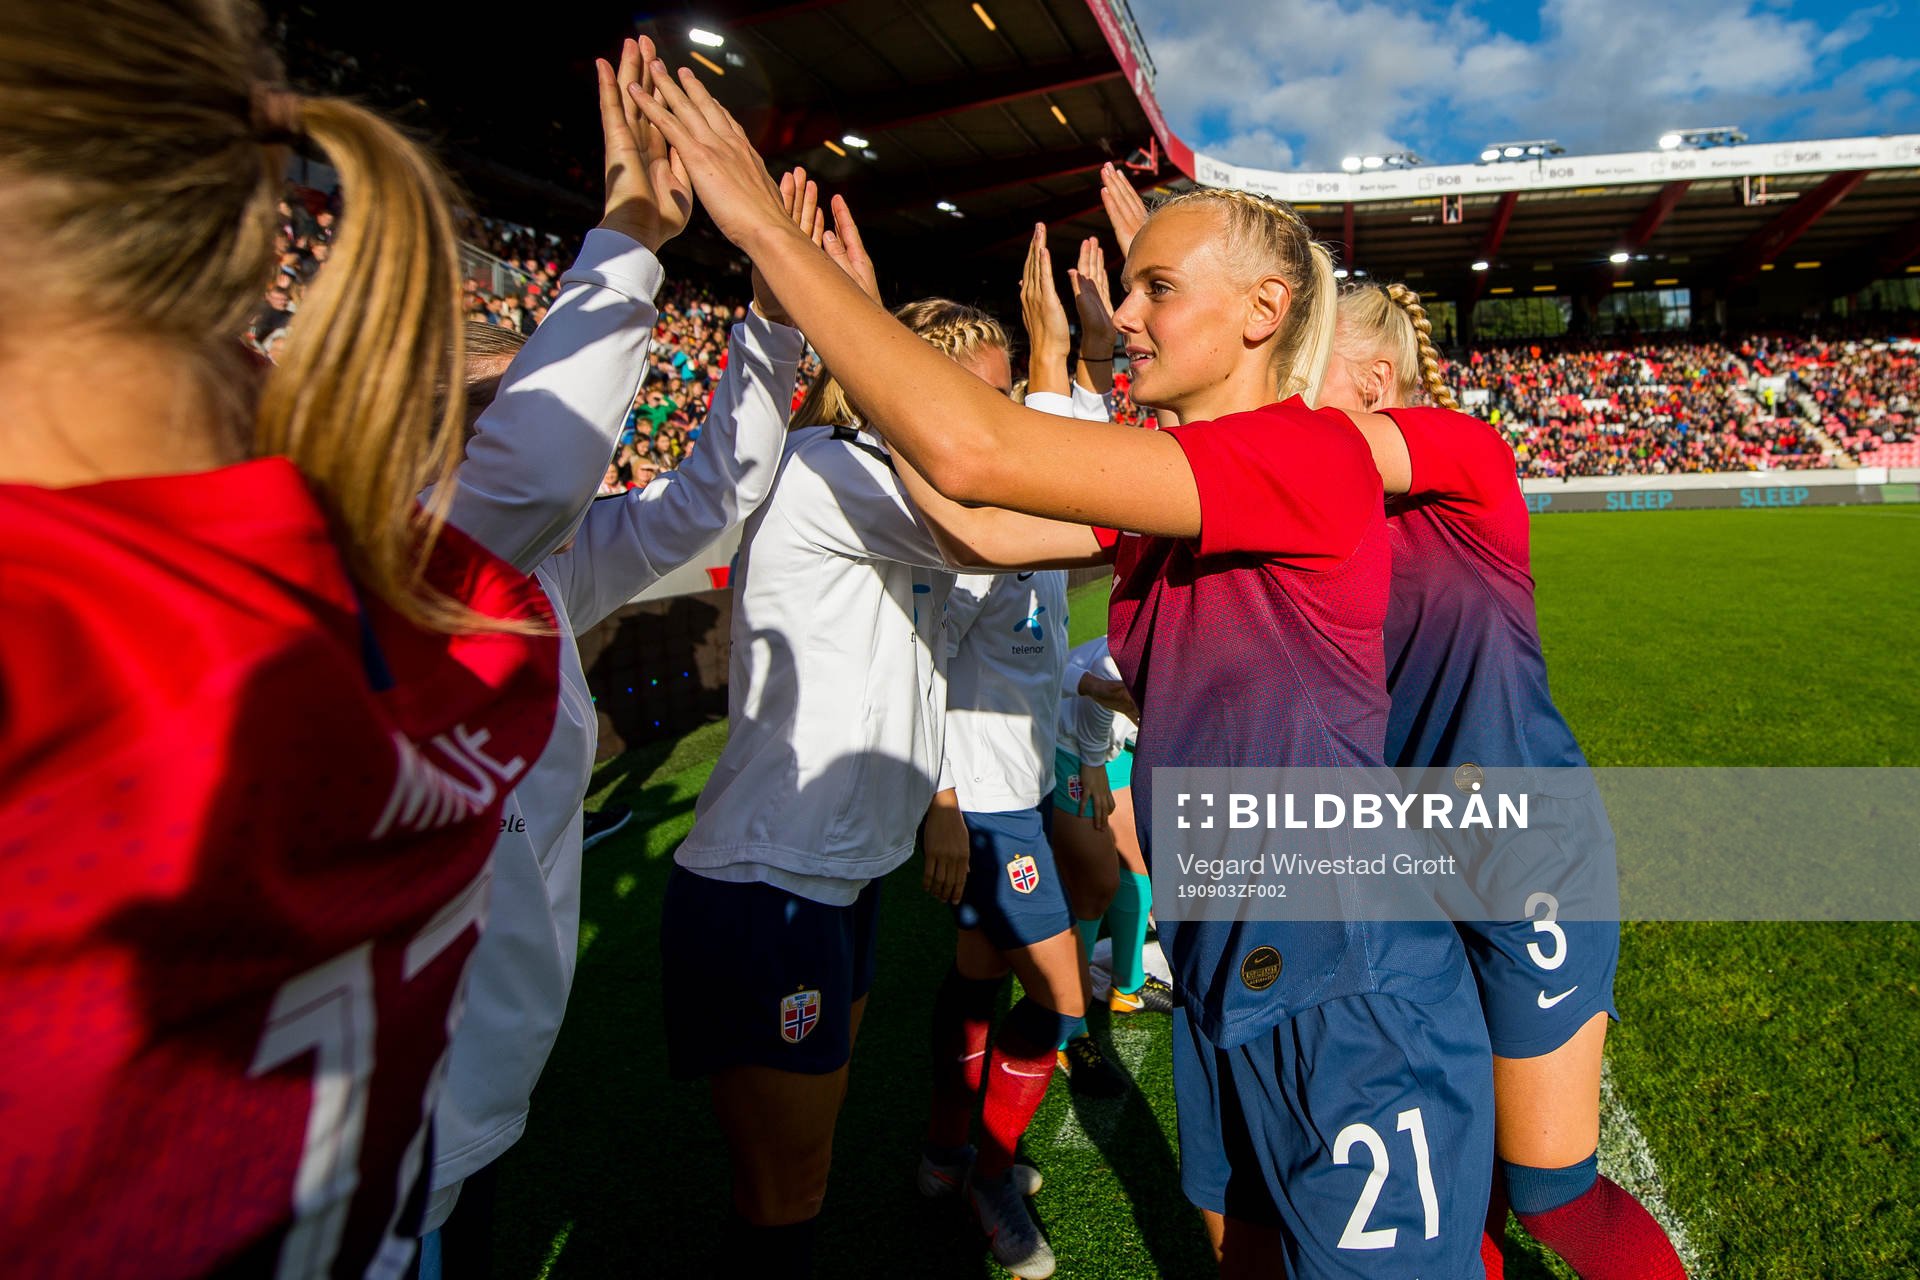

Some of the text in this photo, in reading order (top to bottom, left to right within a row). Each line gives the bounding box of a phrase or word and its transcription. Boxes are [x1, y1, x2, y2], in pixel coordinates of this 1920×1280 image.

[1670, 159, 1697, 170] BOB
[1548, 167, 1575, 178] BOB
[1436, 174, 1462, 186] BOB
[1315, 182, 1341, 193] BOB
[1605, 490, 1674, 511] SLEEP
[1739, 487, 1810, 508] SLEEP
[1011, 644, 1046, 655] telenor
[1523, 891, 1568, 971] 3
[1331, 1106, 1440, 1251] 21
